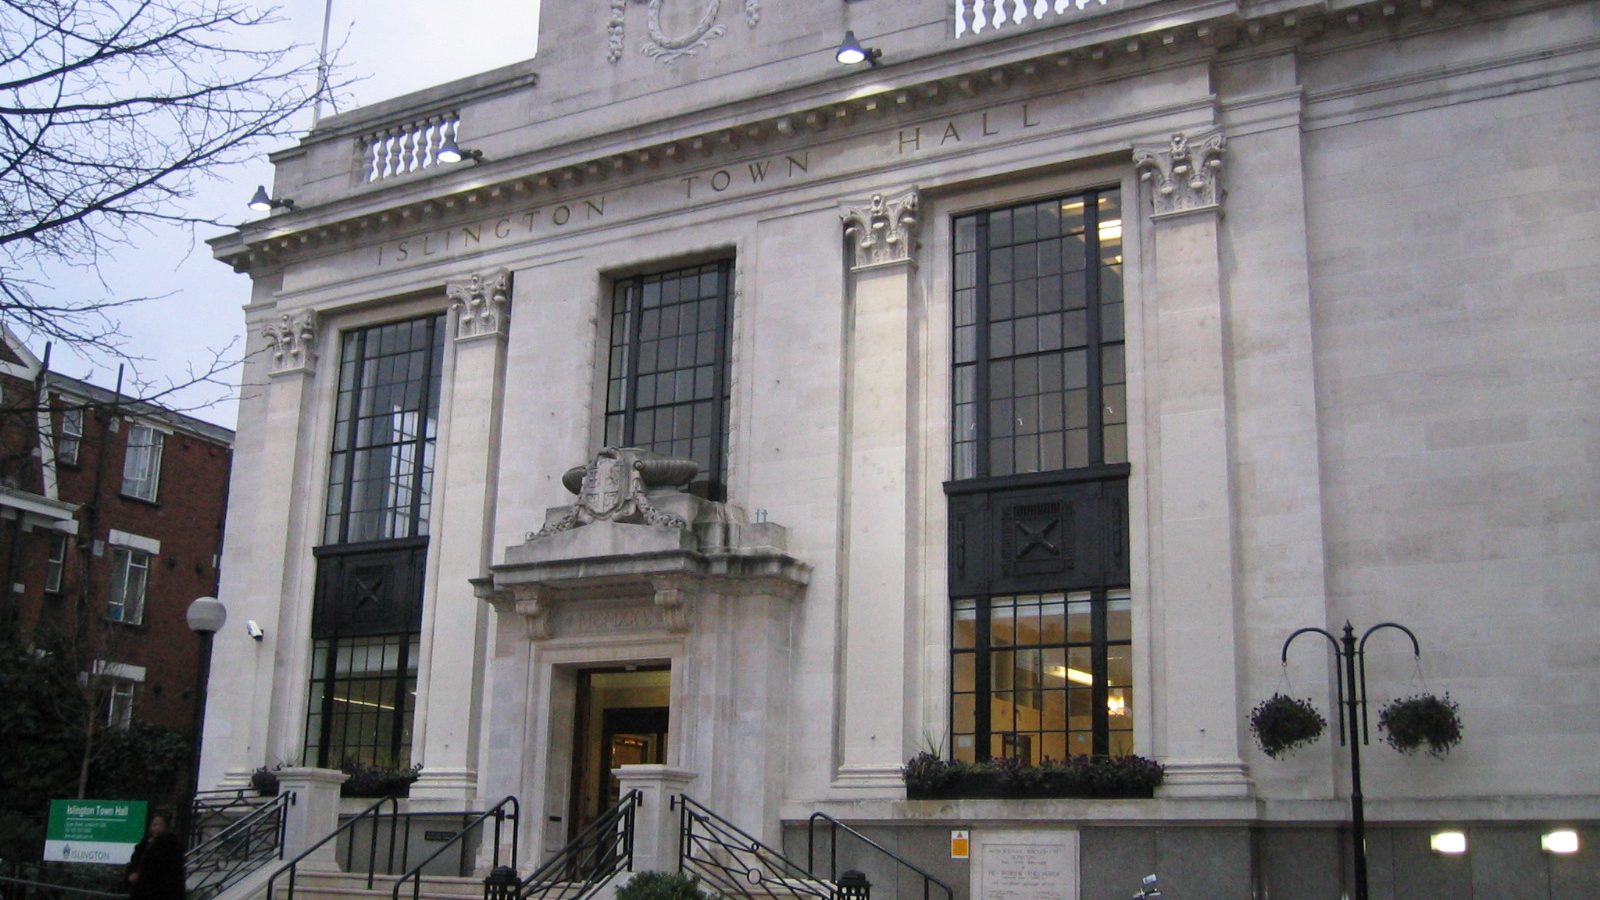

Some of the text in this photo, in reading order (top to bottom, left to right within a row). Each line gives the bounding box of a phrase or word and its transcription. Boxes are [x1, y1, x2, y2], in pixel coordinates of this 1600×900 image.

[377, 104, 1041, 266] ISLINGTON TOWN HALL
[67, 805, 128, 817] Islington Town Hall
[70, 849, 110, 860] ISLINGTON
